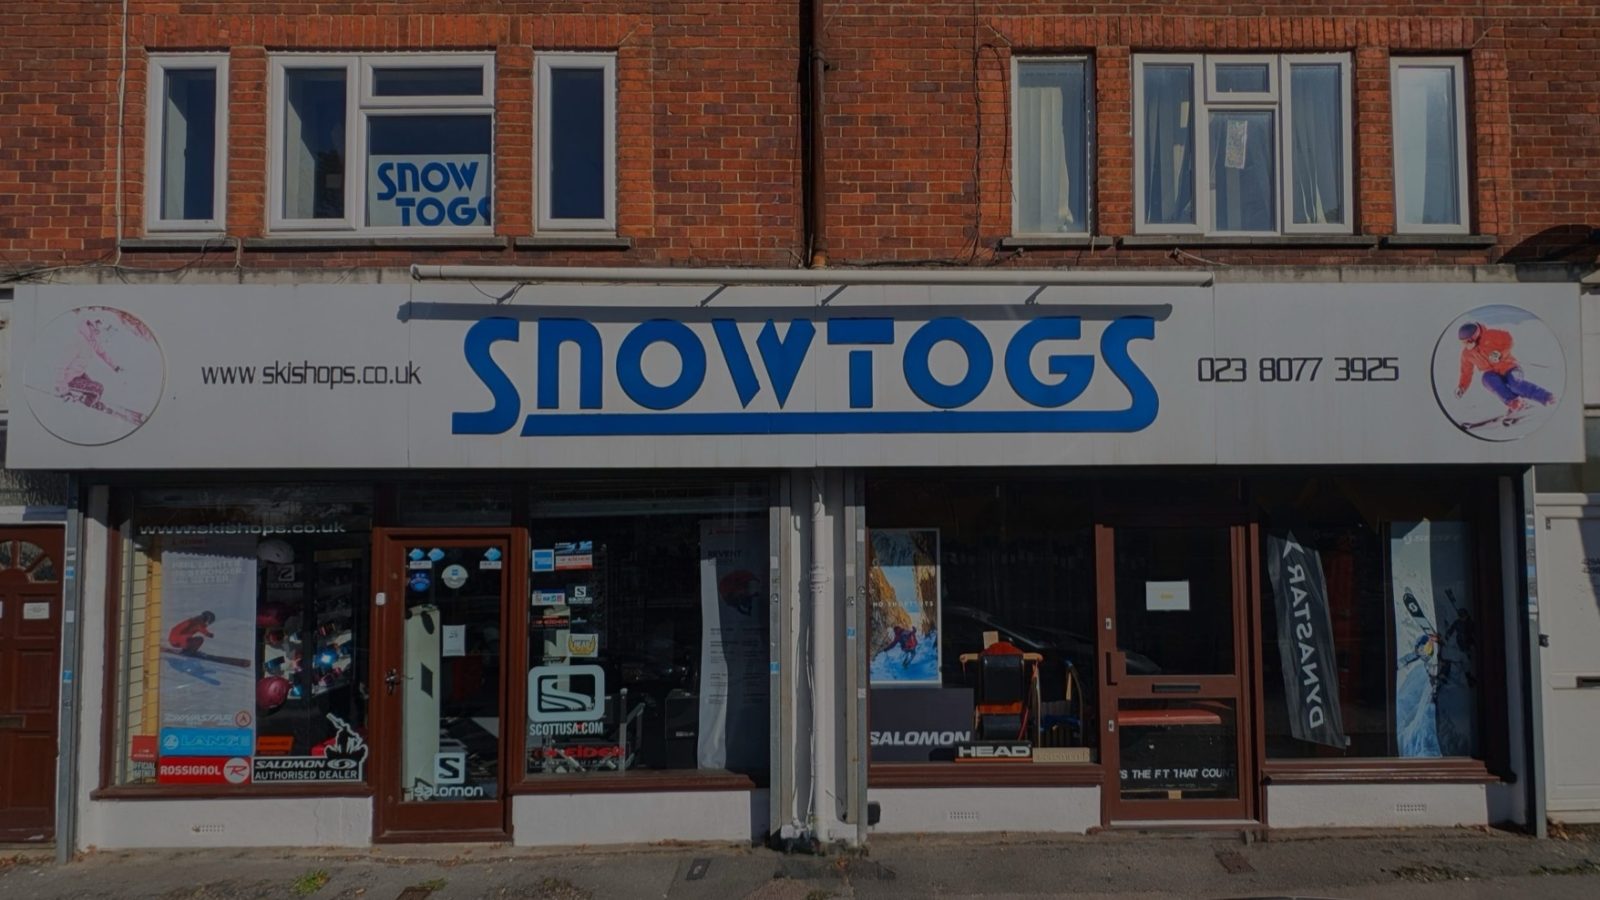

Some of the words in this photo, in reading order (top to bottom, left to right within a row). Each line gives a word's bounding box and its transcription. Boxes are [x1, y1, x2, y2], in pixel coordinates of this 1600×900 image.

[377, 162, 479, 201] SNOW
[1198, 357, 1247, 382] 023
[1259, 357, 1323, 382] 8077
[1334, 357, 1399, 382] 3925
[452, 317, 1159, 436] SNOWTOGS
[529, 722, 604, 736] SCOTTUSA.COM
[870, 730, 971, 746] SALOMON
[958, 745, 1031, 757] HEAD
[160, 765, 221, 776] ROSSIGNOL
[255, 759, 326, 769] SALOMON
[254, 770, 317, 780] AUTHORISED
[319, 770, 358, 780] DEALER
[1131, 769, 1151, 779] THE
[1154, 768, 1170, 779] FT
